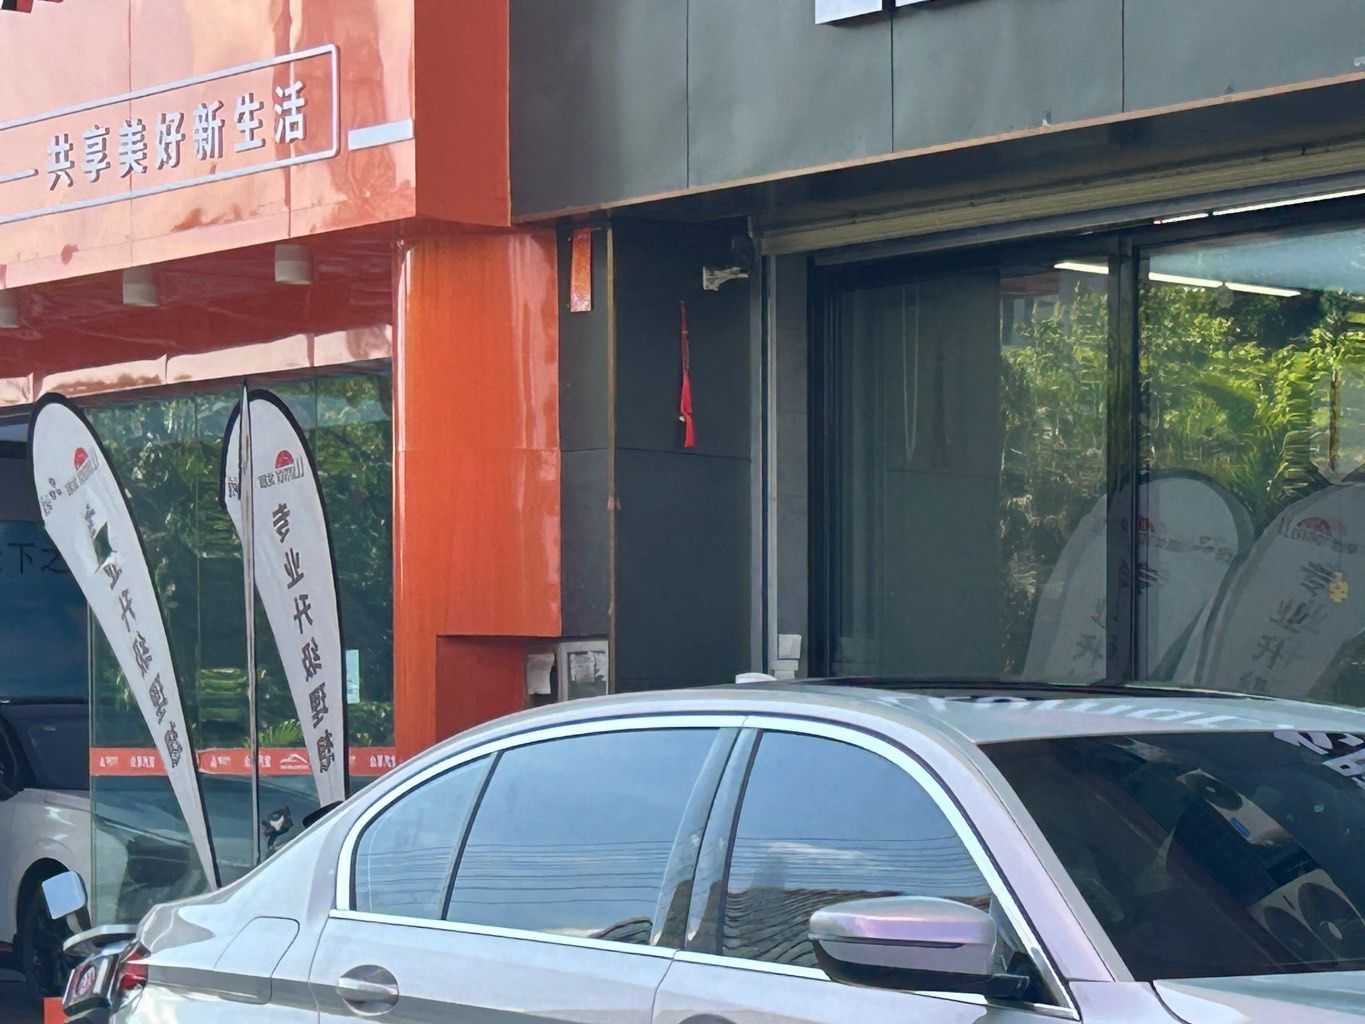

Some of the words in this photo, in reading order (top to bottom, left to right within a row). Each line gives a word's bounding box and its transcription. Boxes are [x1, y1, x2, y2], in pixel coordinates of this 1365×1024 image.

[47, 81, 306, 190] 共享美好新生活
